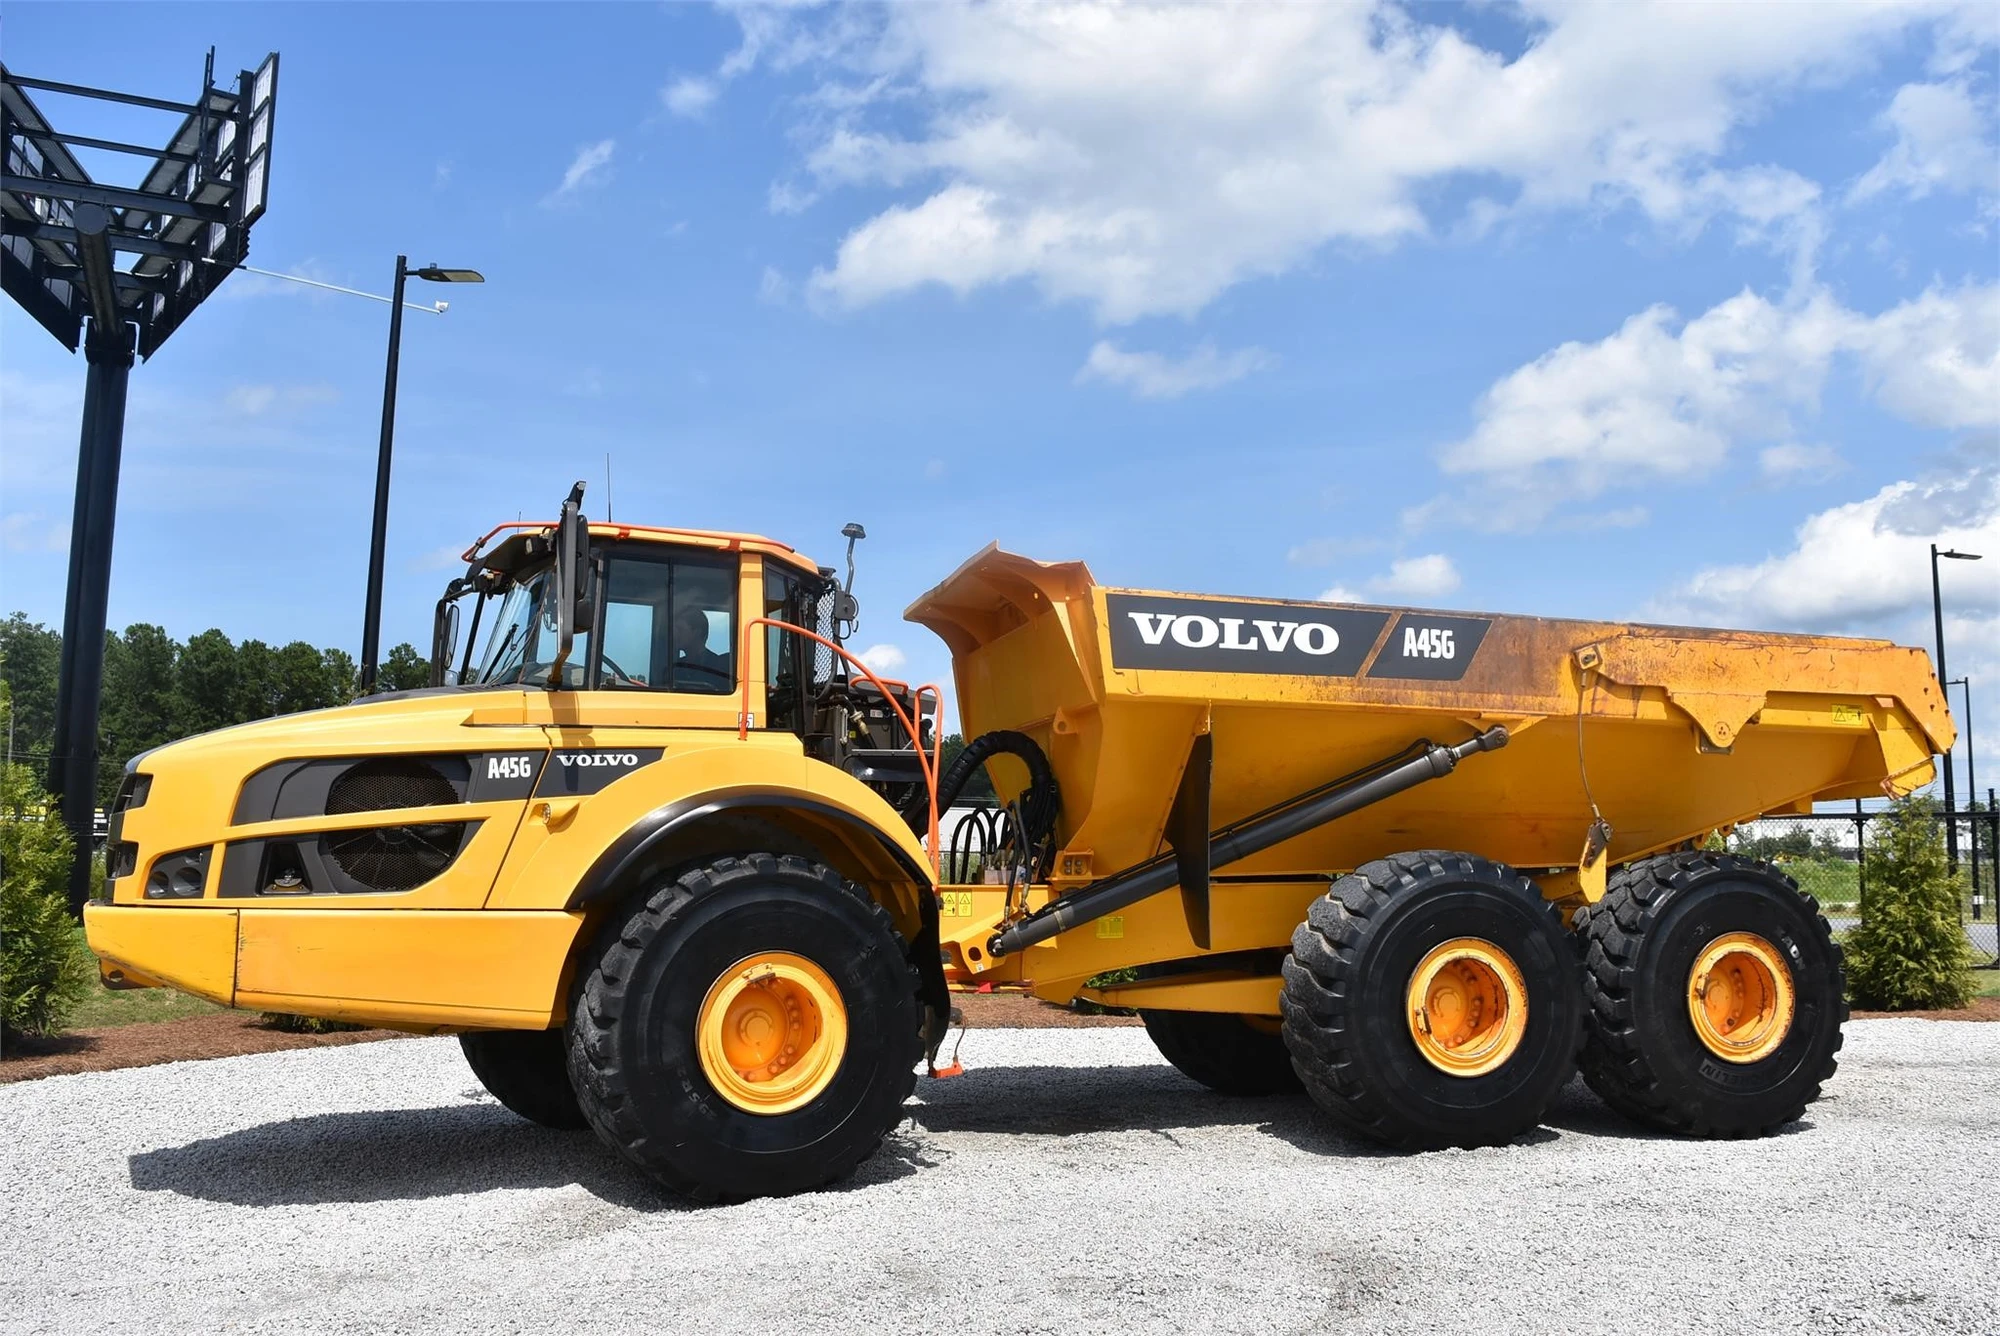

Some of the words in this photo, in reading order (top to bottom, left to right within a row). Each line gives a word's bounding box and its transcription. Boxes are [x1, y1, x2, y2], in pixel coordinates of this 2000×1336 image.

[1128, 611, 1340, 655] VOLVO
[1403, 628, 1454, 659] A45G
[488, 757, 531, 778] A45G
[557, 754, 638, 766] VOLVO
